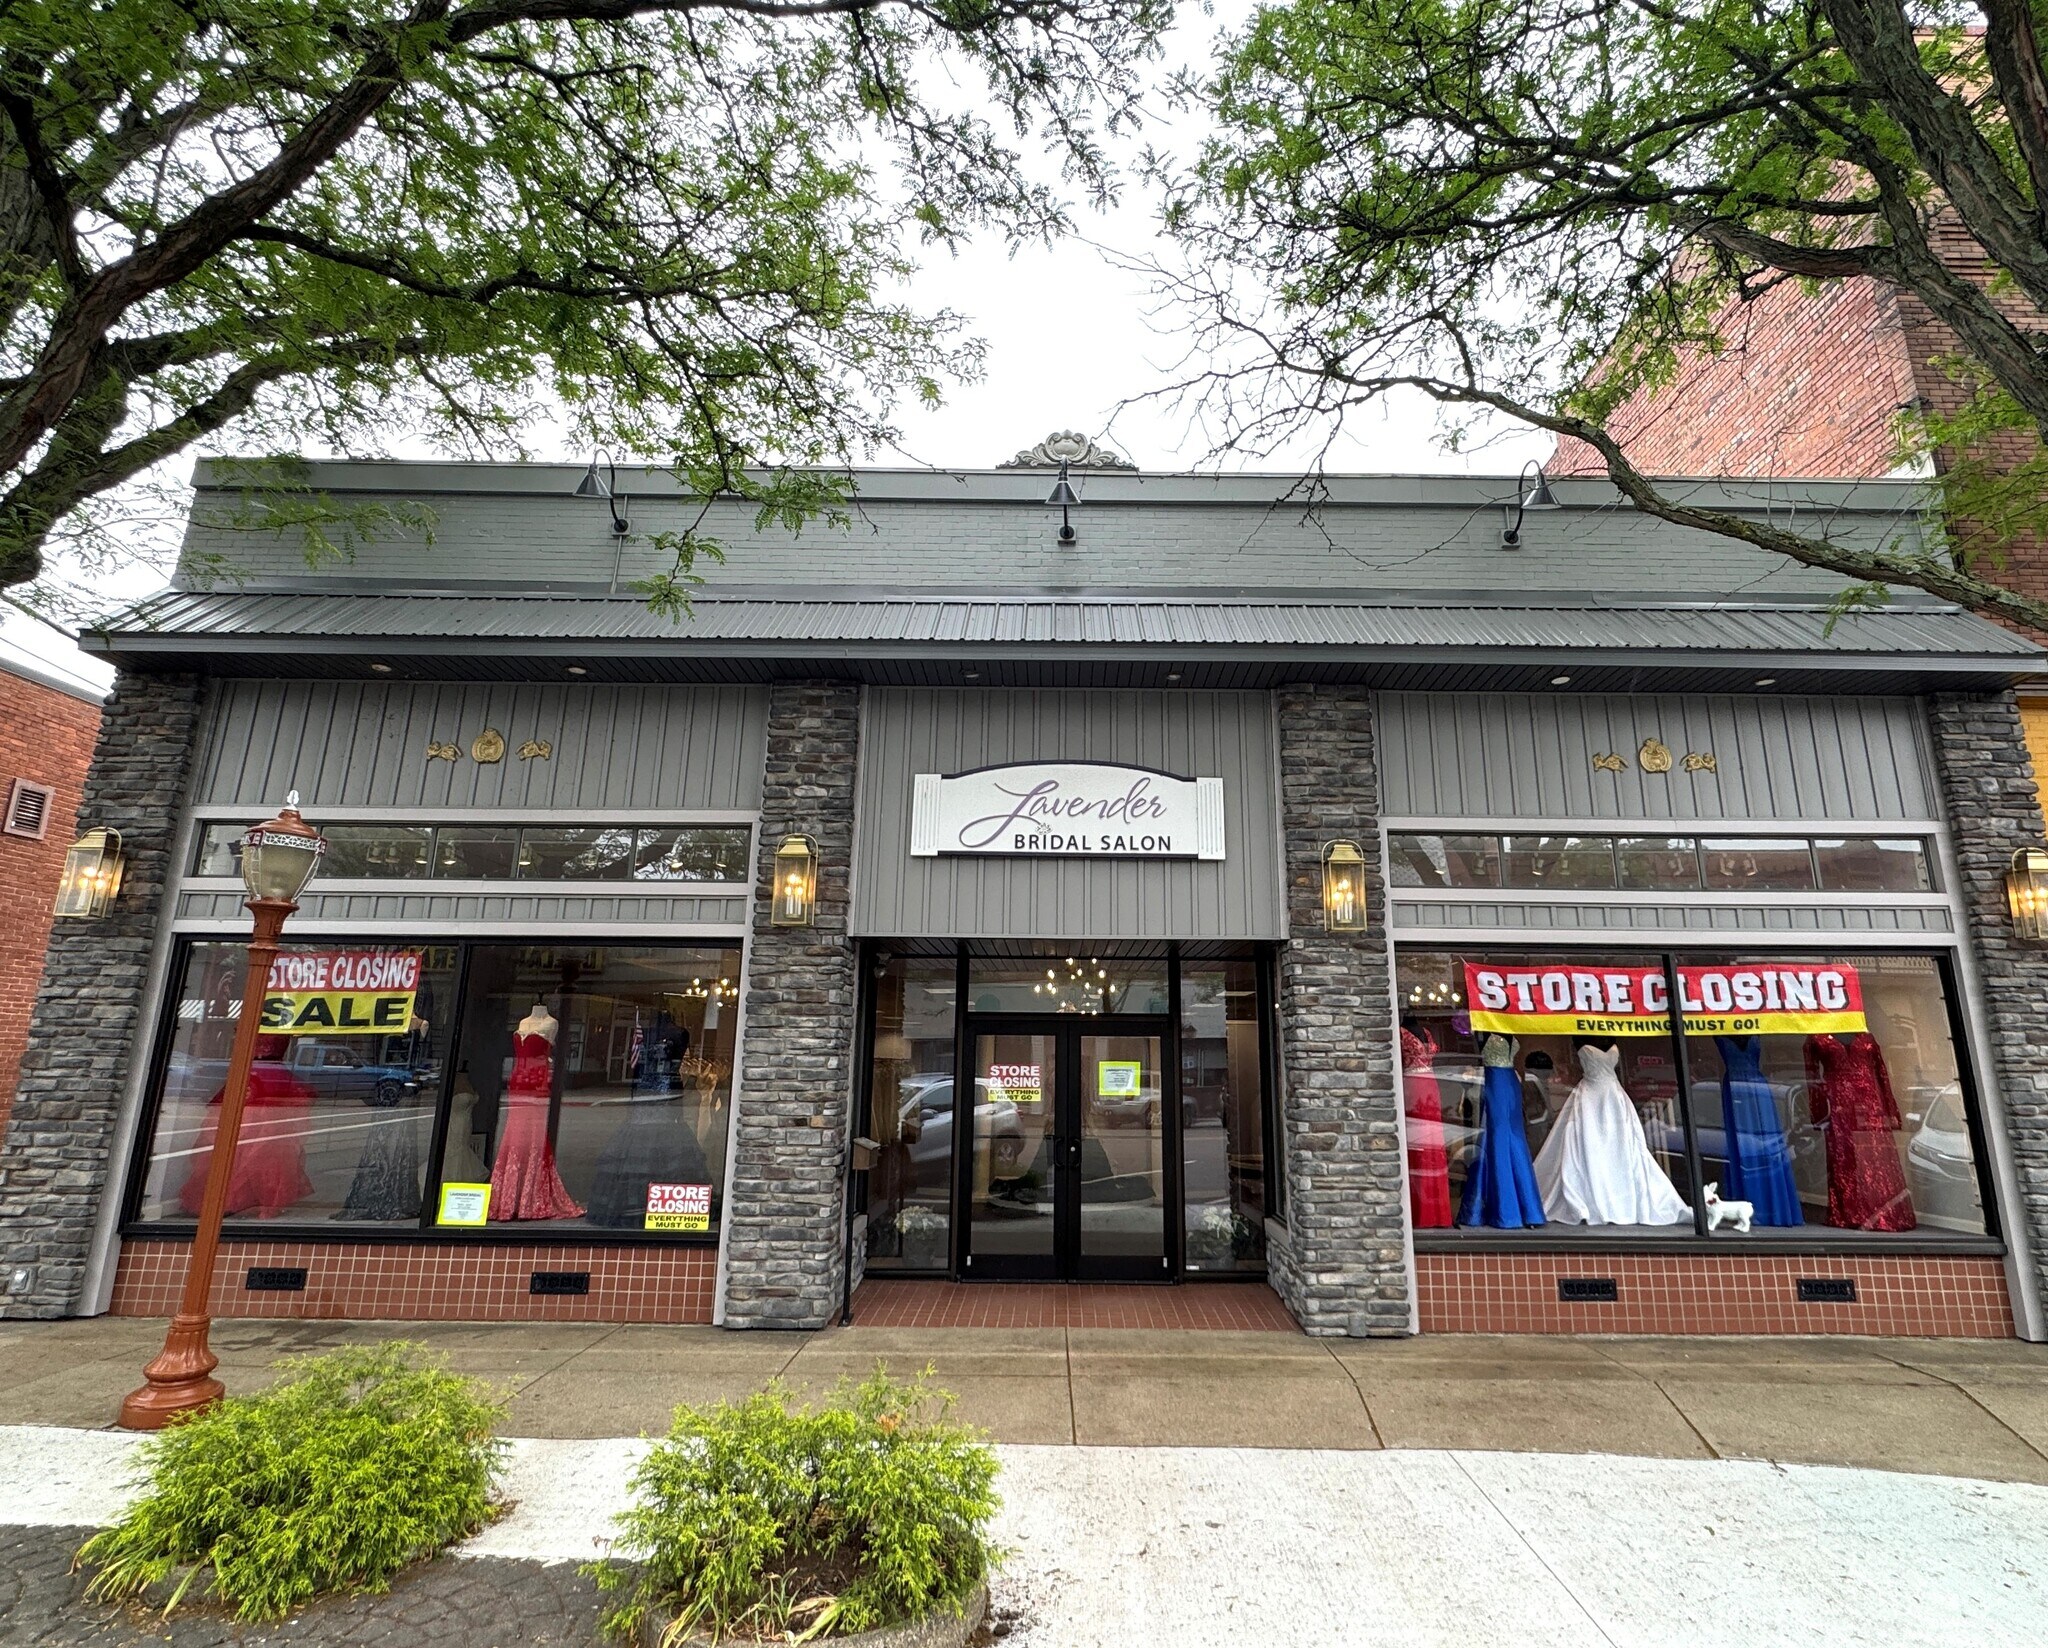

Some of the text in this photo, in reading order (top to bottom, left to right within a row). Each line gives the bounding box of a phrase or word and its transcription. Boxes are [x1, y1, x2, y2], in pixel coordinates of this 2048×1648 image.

[959, 777, 1167, 848] Lavender
[1014, 834, 1171, 851] BRIDAL SALON
[267, 957, 329, 988] STORE
[332, 956, 416, 988] CLOSING
[1476, 970, 1848, 1013] STORE CLOSING
[260, 997, 409, 1027] SALE
[1576, 1019, 1760, 1032] EVERYTHING MUST GO!
[990, 1065, 1040, 1076] STORE
[990, 1077, 1040, 1087] CLOSING
[650, 1185, 710, 1199] STORE
[648, 1199, 709, 1213] CLOSING
